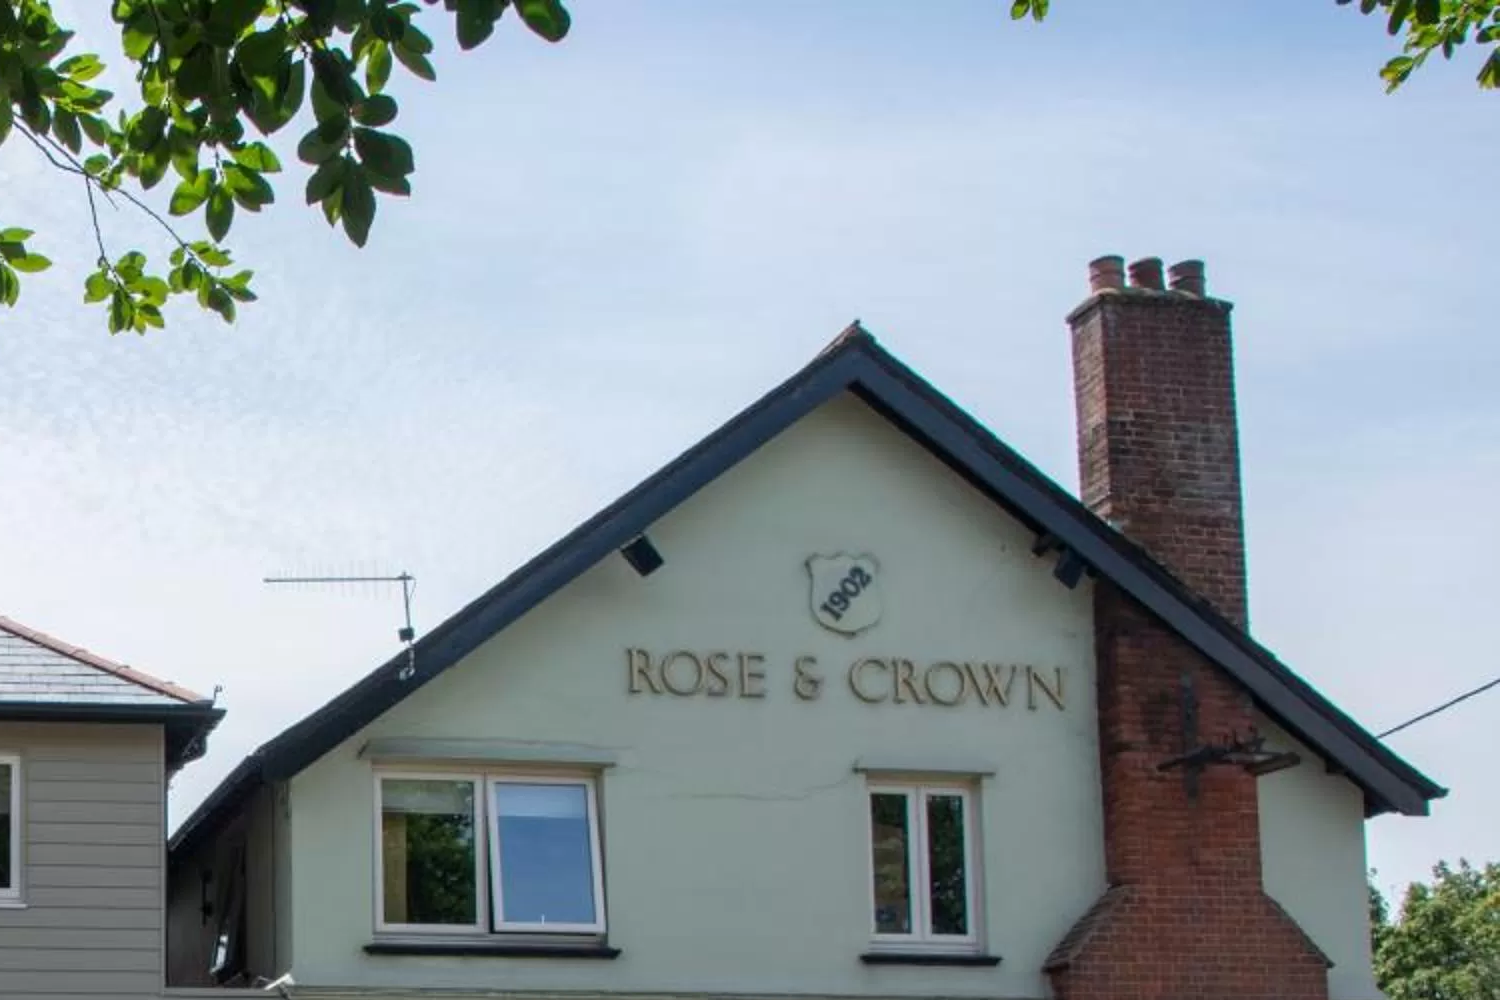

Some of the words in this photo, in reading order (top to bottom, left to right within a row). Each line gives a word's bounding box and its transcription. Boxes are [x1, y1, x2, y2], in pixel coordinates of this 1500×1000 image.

[819, 565, 873, 622] 1902
[625, 647, 766, 699] ROSE
[793, 655, 825, 702] &
[848, 657, 1066, 711] CROWN
